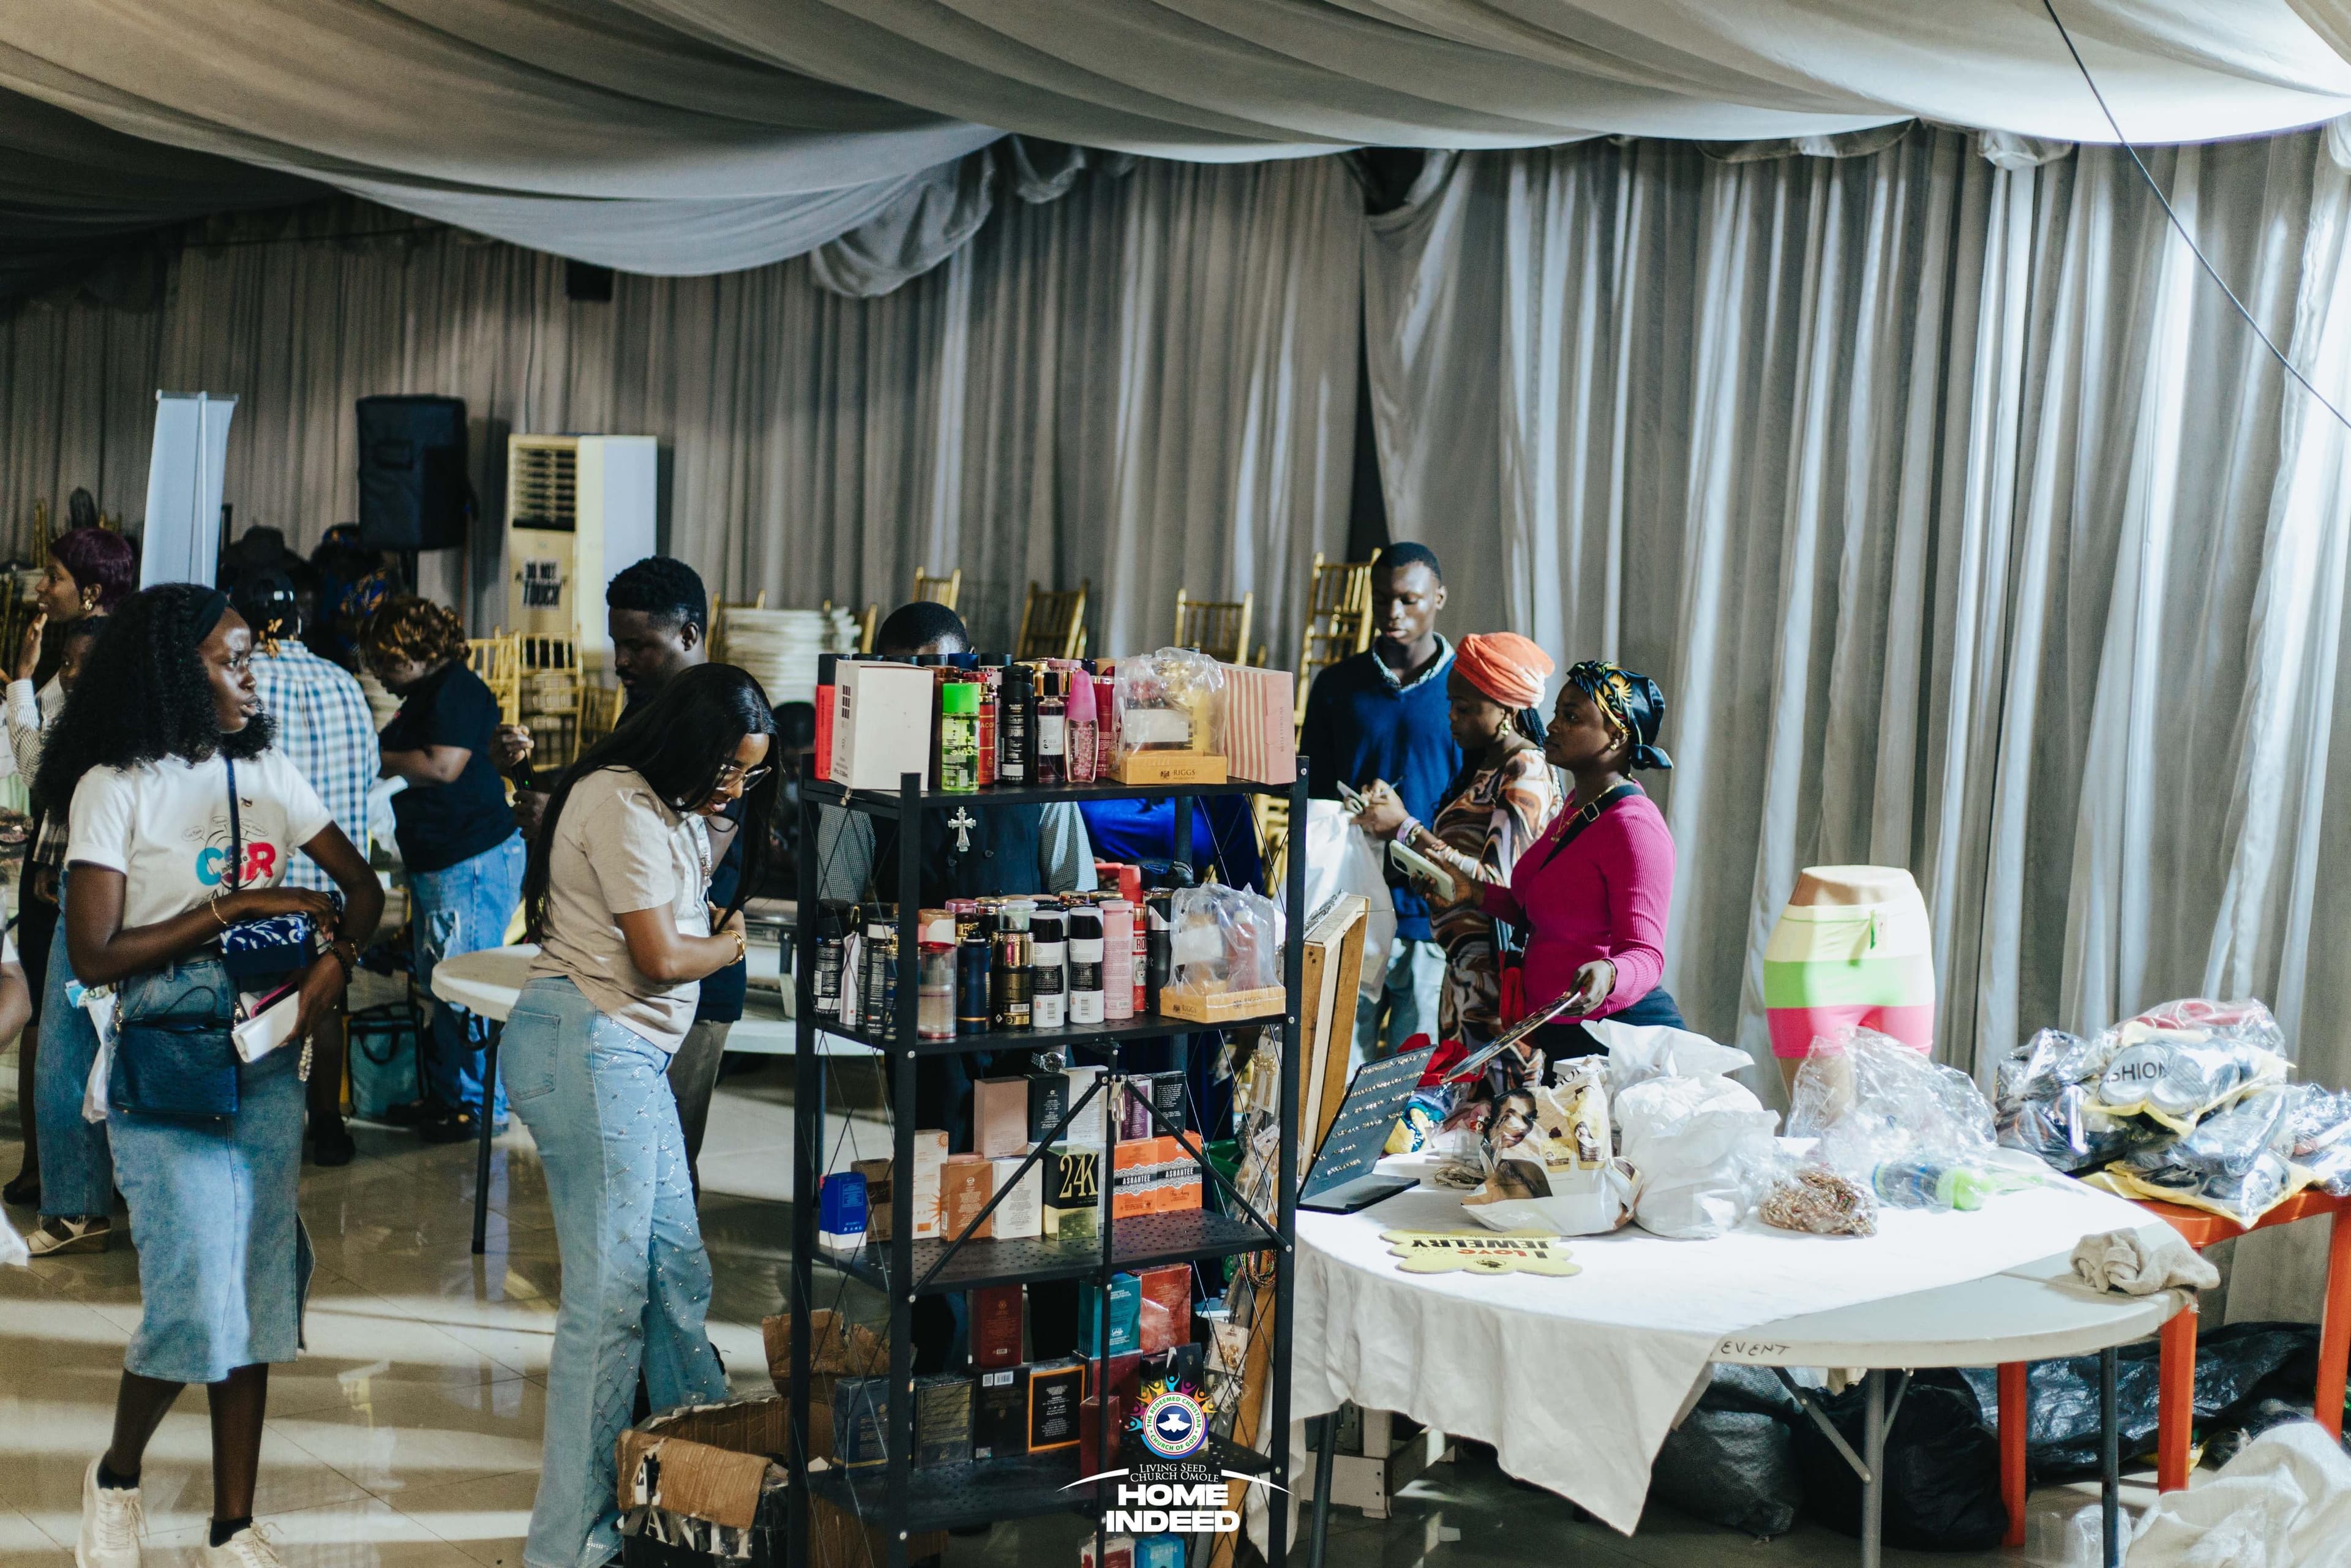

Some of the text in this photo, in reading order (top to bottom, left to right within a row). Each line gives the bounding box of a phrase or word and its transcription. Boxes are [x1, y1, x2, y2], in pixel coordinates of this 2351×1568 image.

[1059, 1153, 1098, 1198] 24K
[1166, 1167, 1194, 1178] ASHANTEE
[1122, 1174, 1151, 1185] ASHANTEE
[1411, 1239, 1550, 1250] JEWELRY
